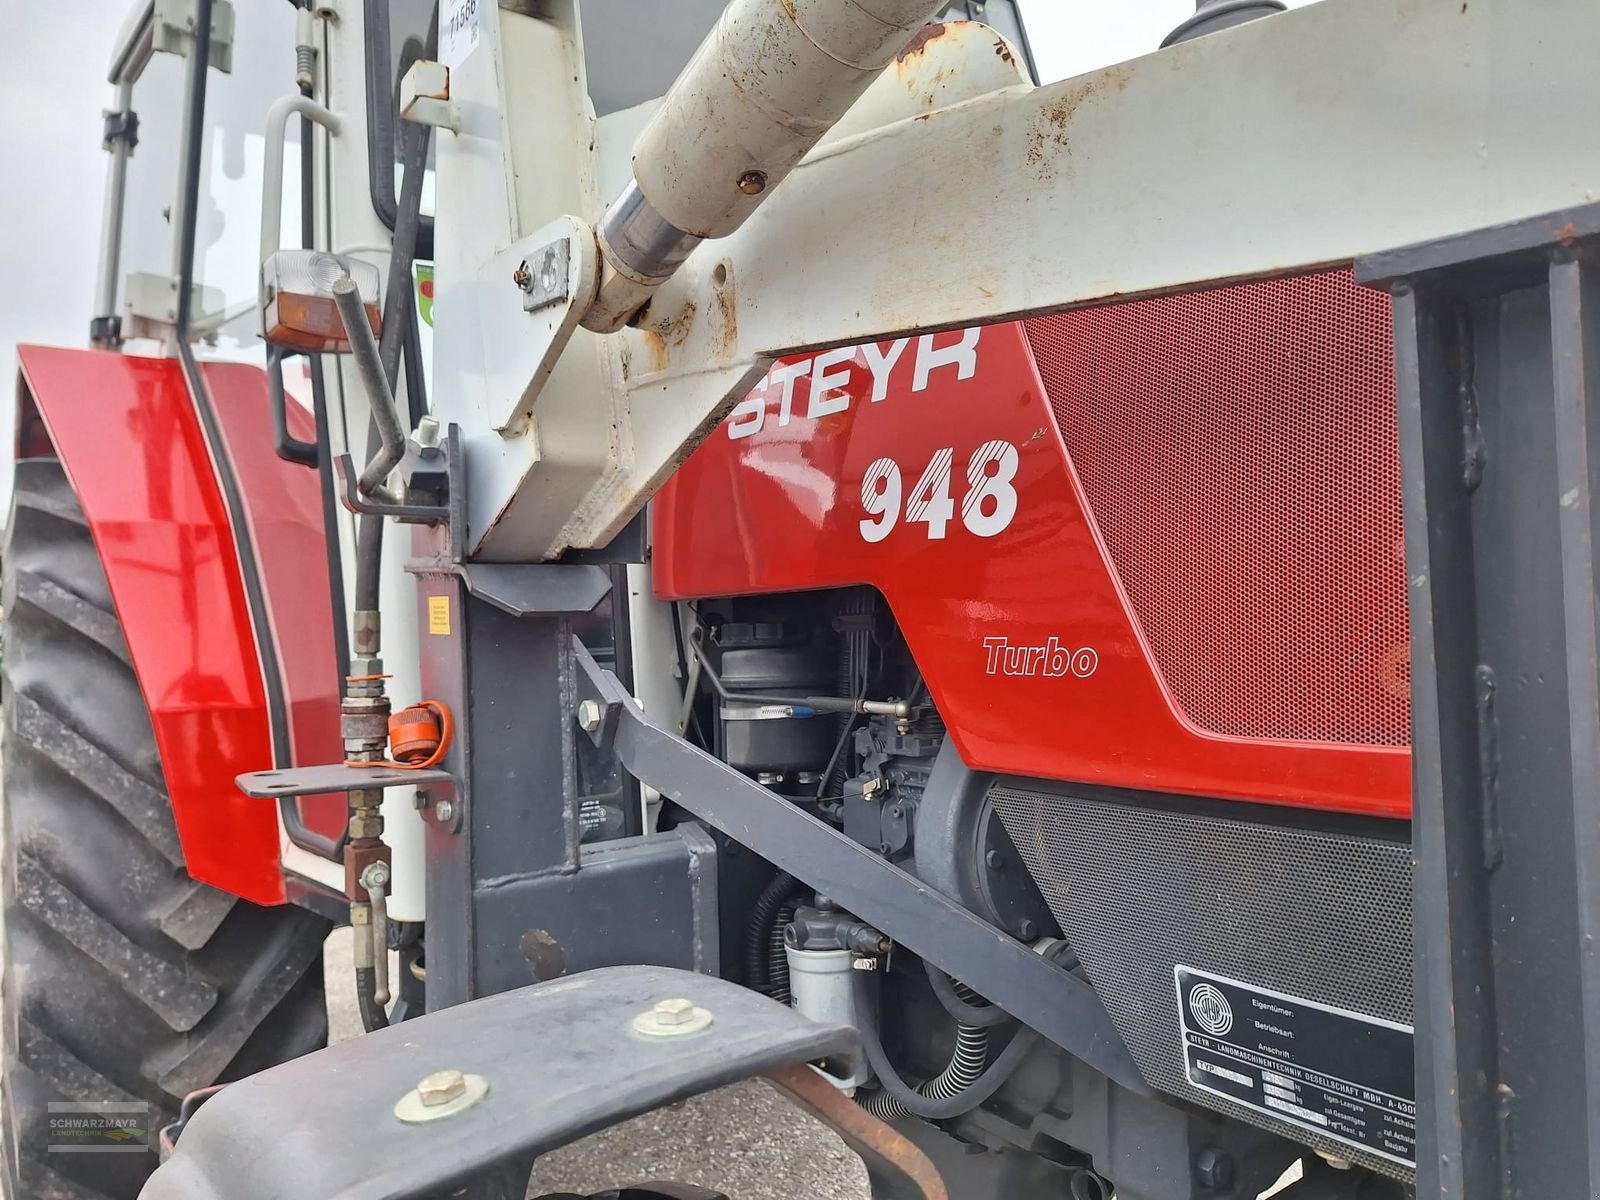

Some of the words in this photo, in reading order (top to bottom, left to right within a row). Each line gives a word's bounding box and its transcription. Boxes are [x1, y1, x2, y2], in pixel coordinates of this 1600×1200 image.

[728, 326, 982, 441] STEYR
[859, 439, 1020, 544] 948
[983, 636, 1099, 677] Turbo
[1252, 999, 1295, 1017] Eigentümer:
[1254, 1021, 1295, 1039] Betriebsart:
[1190, 1034, 1210, 1047] STEYR
[1217, 1044, 1303, 1078] LANDMASCHINENTECHNIK
[1305, 1074, 1359, 1097] GESELLSCHAFT
[1199, 1061, 1215, 1072] TYP
[1384, 1139, 1408, 1153] Baujahr
